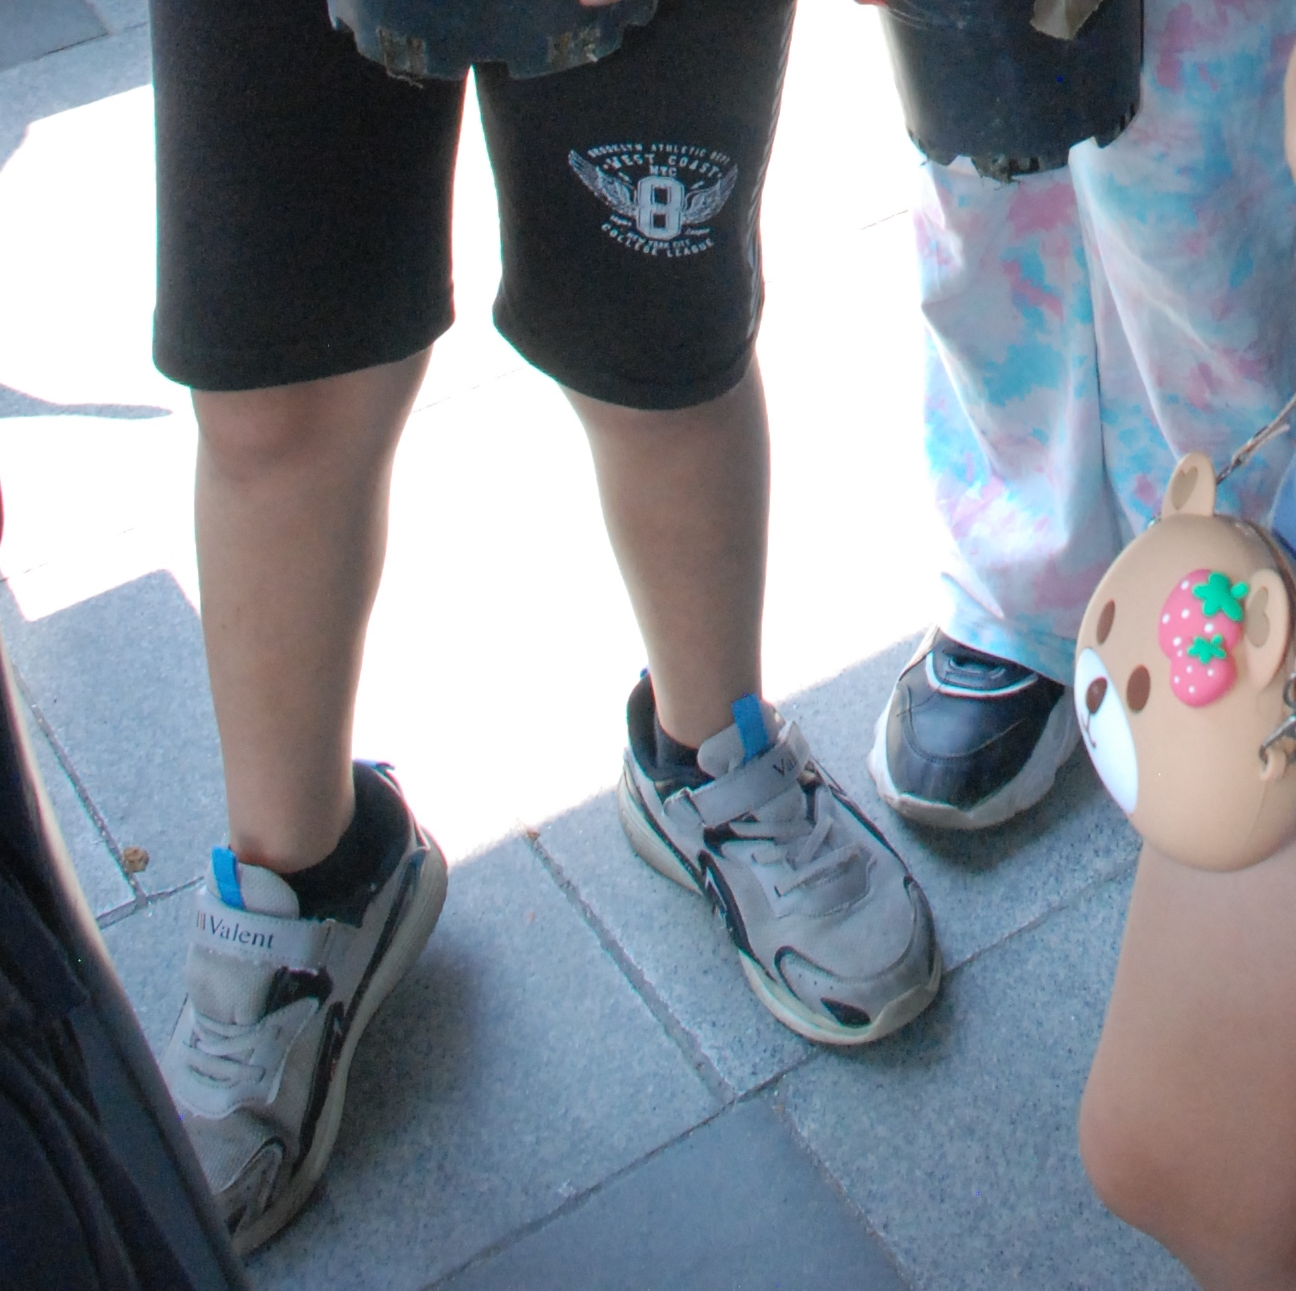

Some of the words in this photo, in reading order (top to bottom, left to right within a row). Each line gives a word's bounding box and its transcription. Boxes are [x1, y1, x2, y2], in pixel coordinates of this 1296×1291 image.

[651, 143, 707, 158] ATHLETIC
[649, 165, 678, 177] NYC
[668, 155, 720, 178] COAST
[636, 175, 686, 241] 8
[601, 223, 658, 257] COLLEGE
[667, 238, 714, 258] LEAGUE
[210, 914, 275, 949] Valent
